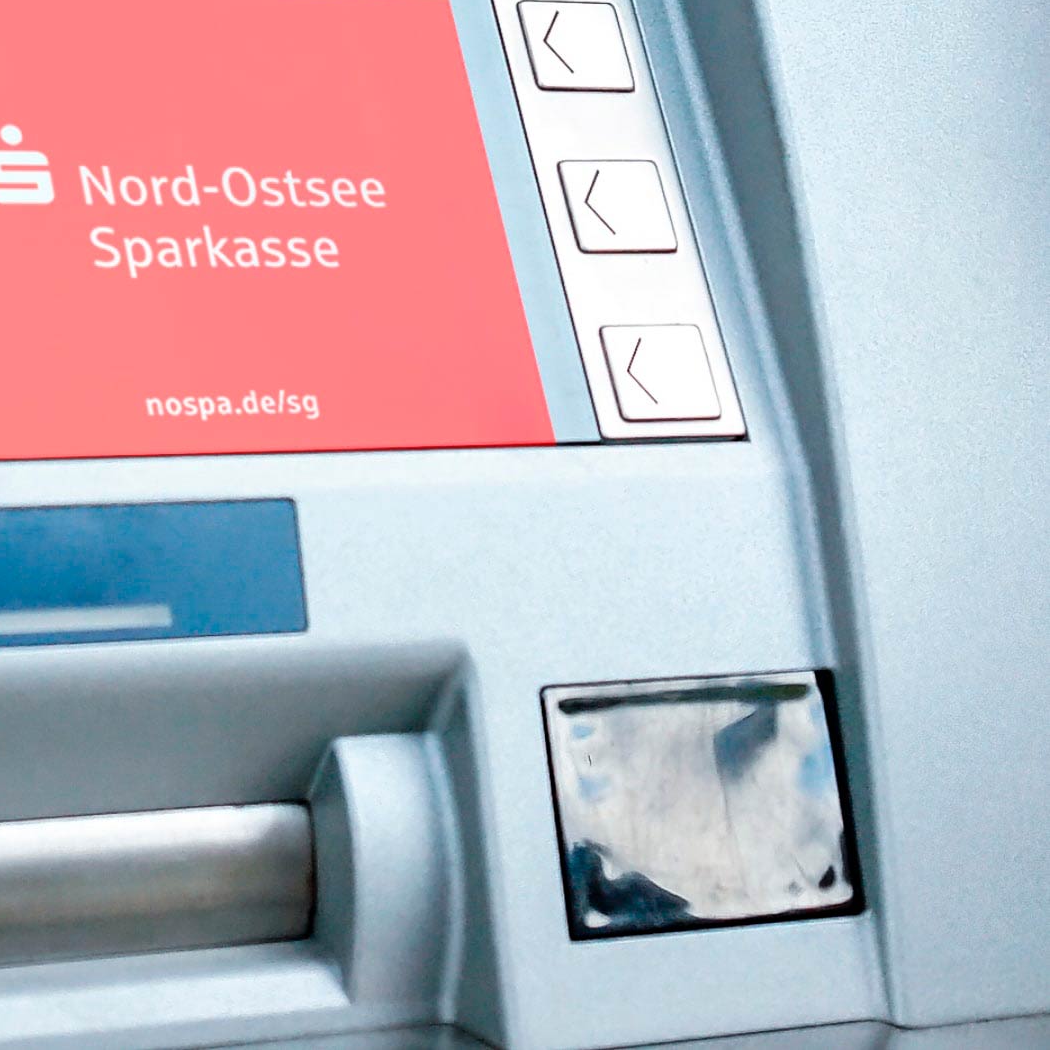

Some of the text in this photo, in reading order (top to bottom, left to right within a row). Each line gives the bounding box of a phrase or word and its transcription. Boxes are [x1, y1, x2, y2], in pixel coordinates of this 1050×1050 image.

[77, 165, 387, 208] Nord-Ostsee
[89, 225, 341, 278] Sparkasse
[145, 389, 320, 421] nospa.de/sg
